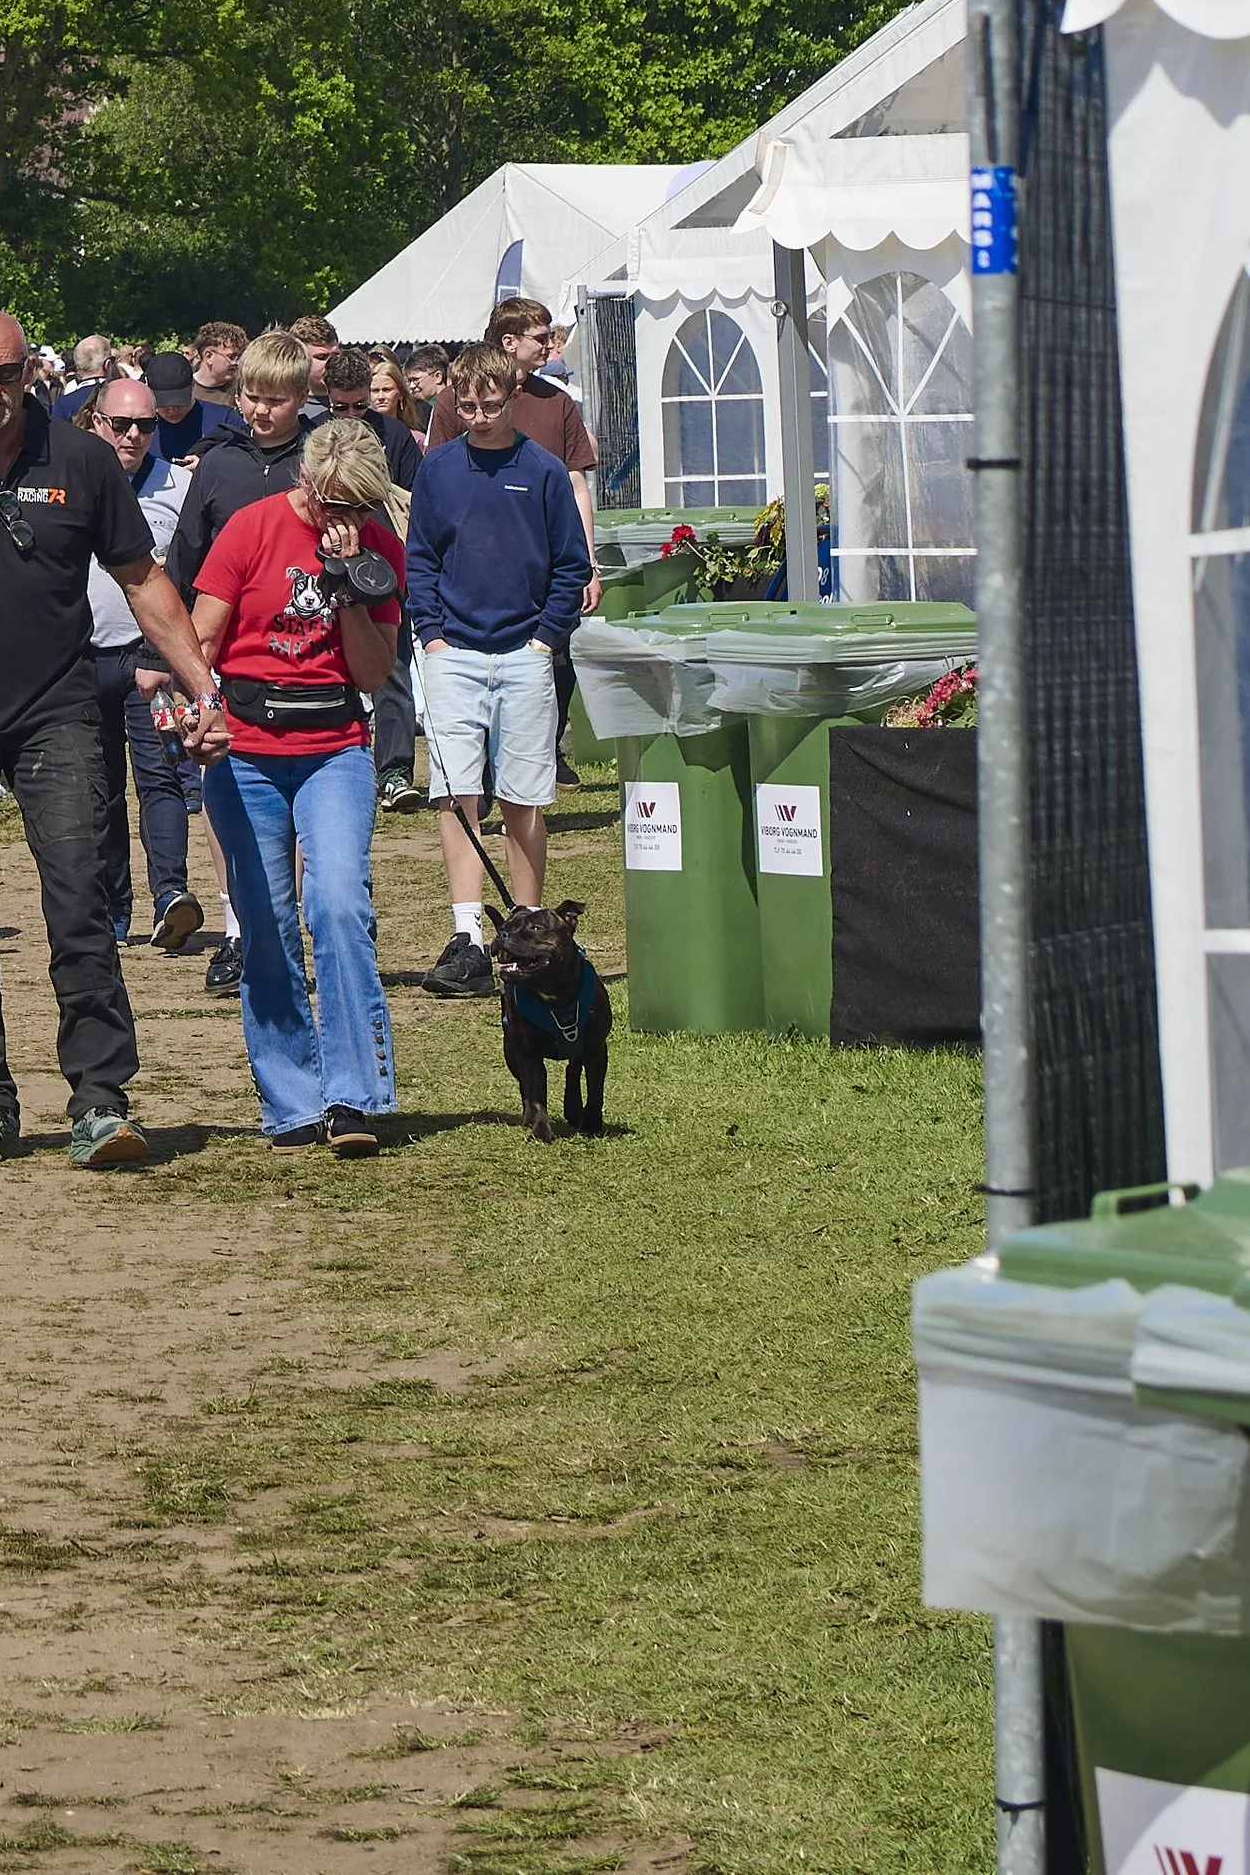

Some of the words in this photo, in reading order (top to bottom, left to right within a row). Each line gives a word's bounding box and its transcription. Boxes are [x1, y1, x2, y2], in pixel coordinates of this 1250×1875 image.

[17, 491, 49, 504] RACING
[639, 823, 678, 834] VOGNMAND
[760, 825, 781, 837] VIBORG
[781, 827, 818, 839] VOGNMAND
